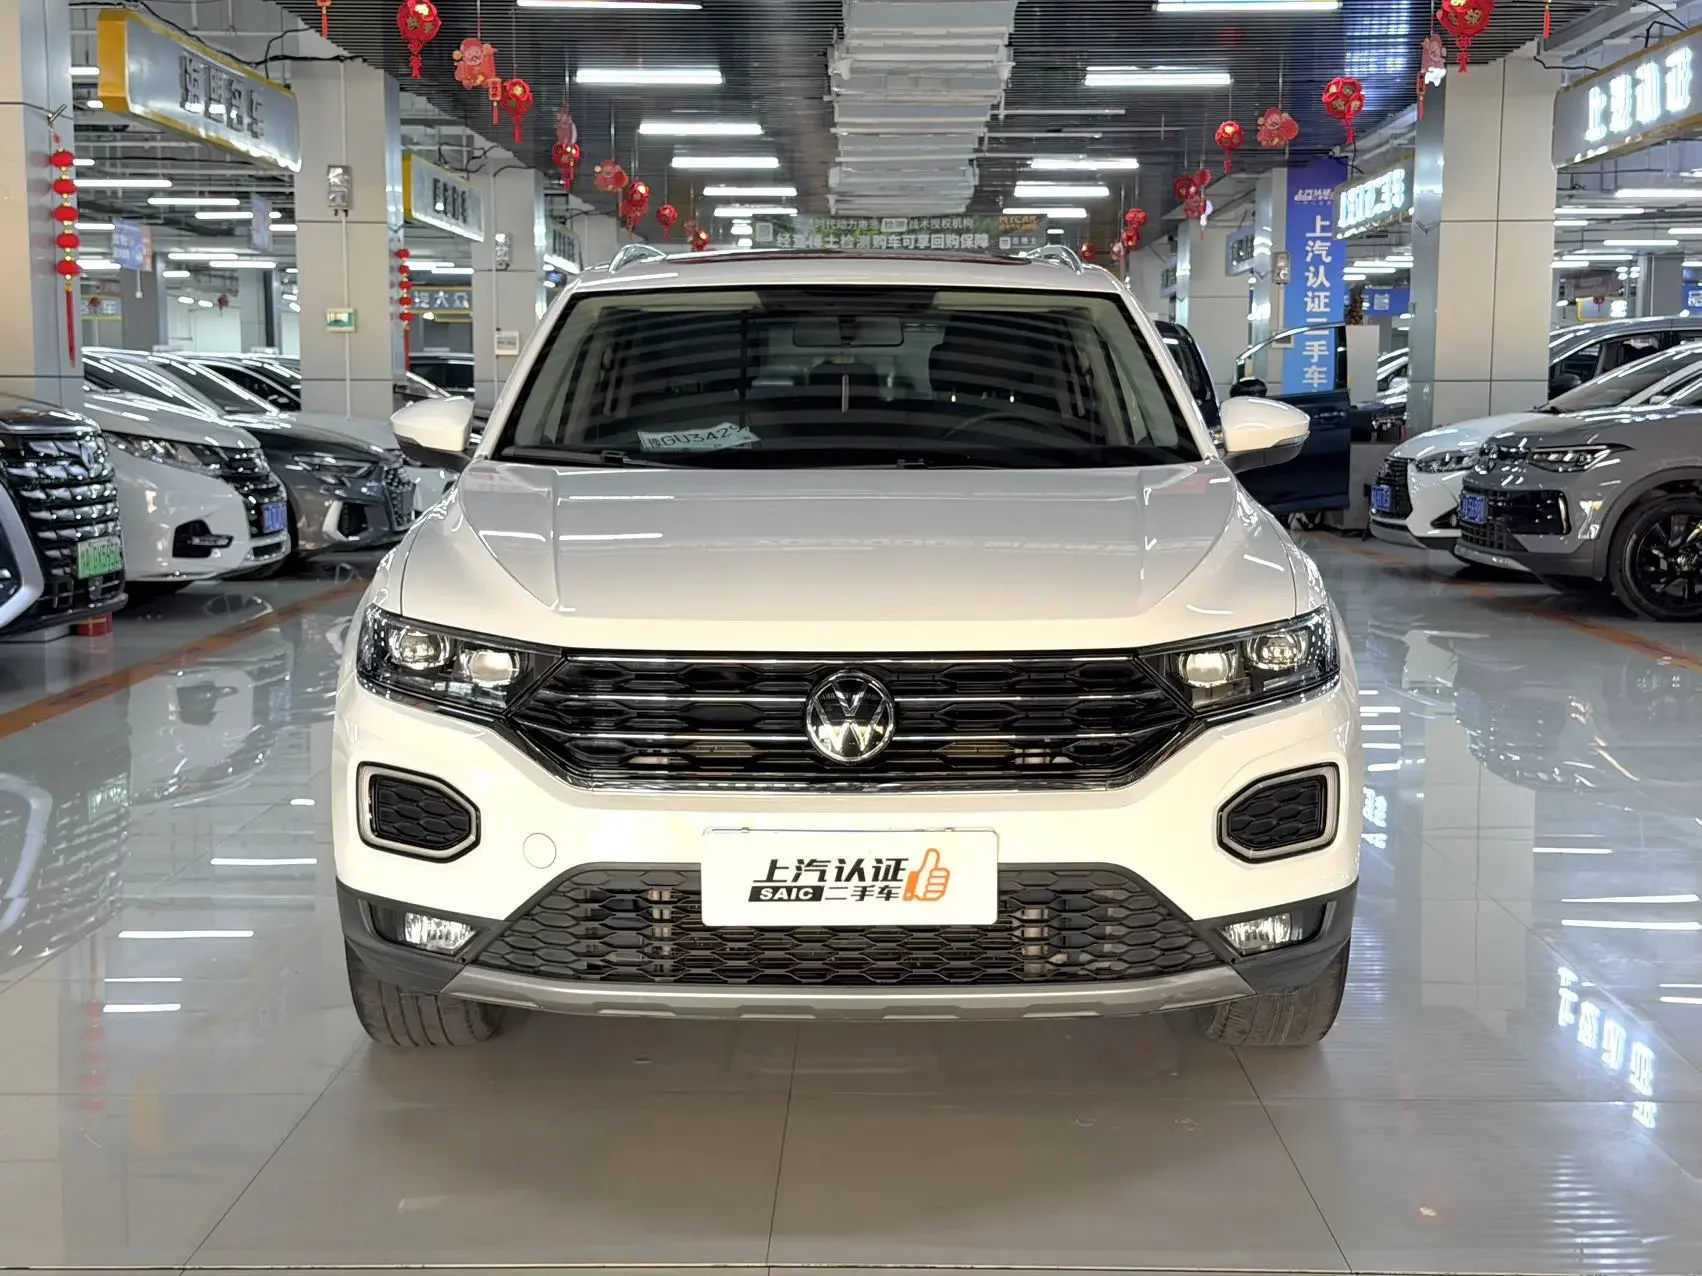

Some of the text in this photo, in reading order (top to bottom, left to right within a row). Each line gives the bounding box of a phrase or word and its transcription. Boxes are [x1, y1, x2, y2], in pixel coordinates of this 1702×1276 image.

[1302, 214, 1333, 388] 上汽认证二手车
[753, 858, 909, 883] 上汽认证
[759, 884, 902, 902] SAIC 二手车
